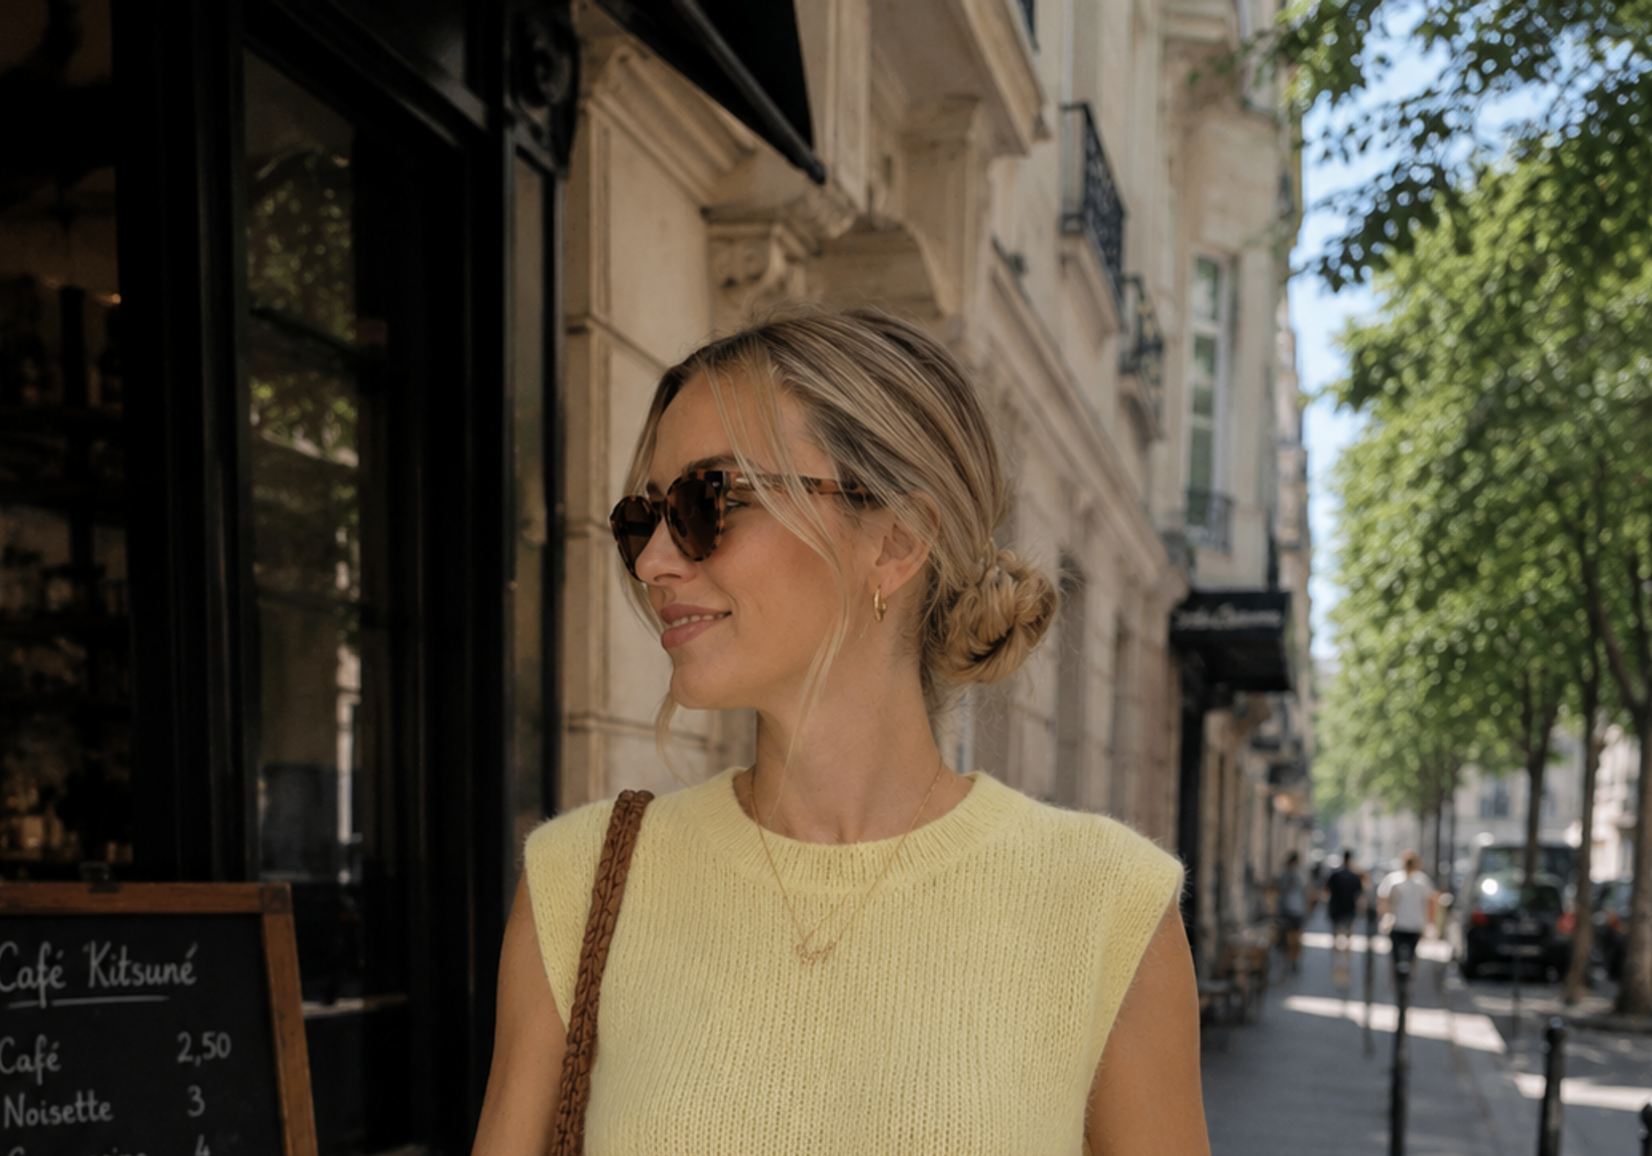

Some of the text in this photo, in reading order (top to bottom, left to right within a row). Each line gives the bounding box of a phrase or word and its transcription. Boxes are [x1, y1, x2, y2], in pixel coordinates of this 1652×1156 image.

[0, 940, 198, 1009] Café Kitsuné
[0, 1031, 232, 1086] Café 2,50
[3, 1084, 206, 1129] Noisette 3
